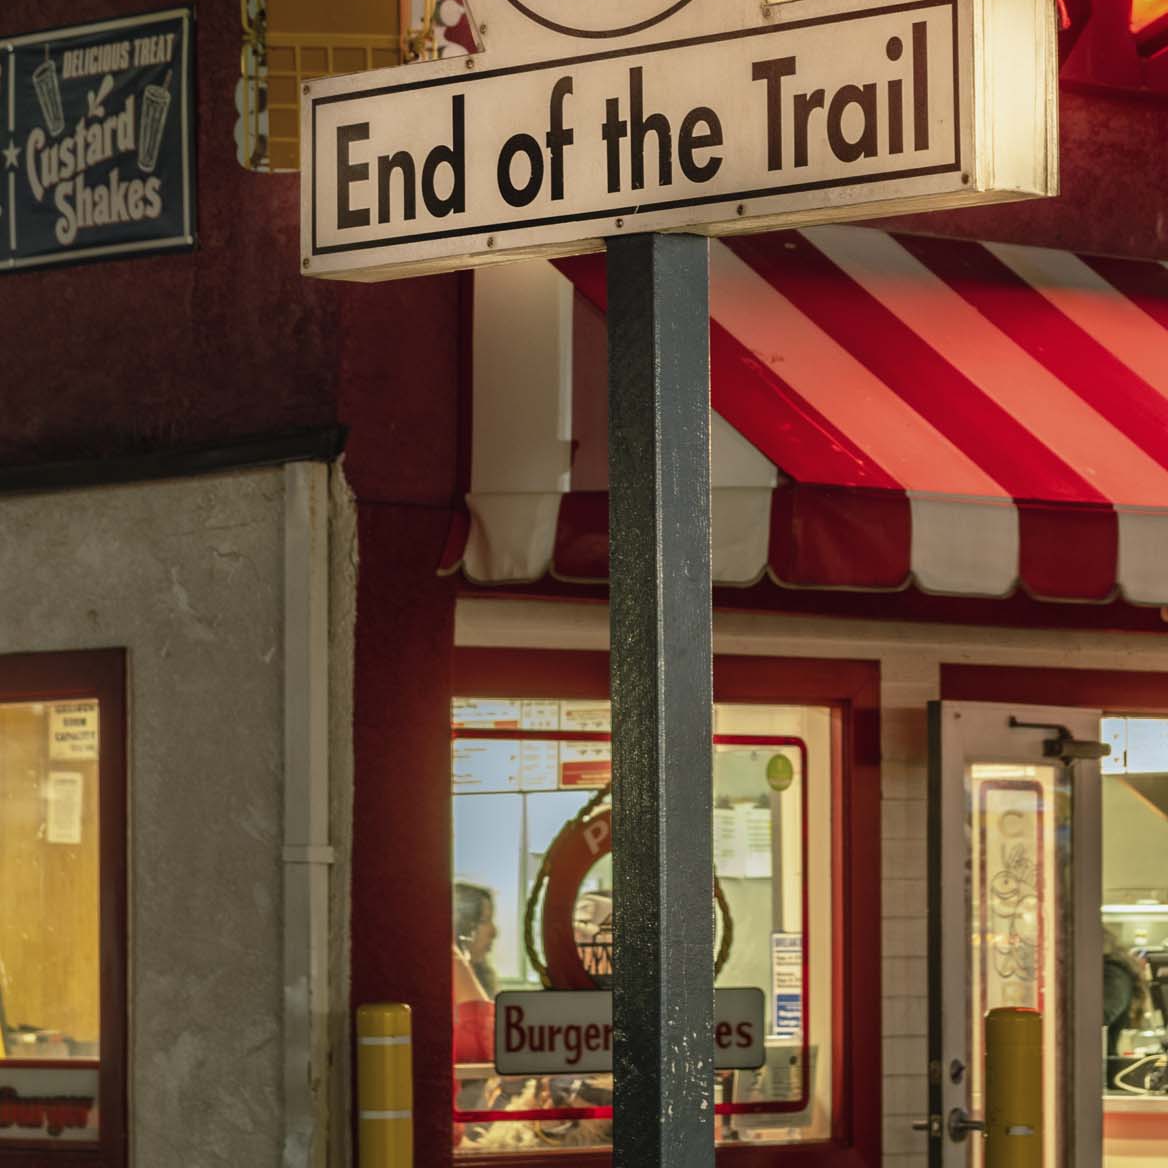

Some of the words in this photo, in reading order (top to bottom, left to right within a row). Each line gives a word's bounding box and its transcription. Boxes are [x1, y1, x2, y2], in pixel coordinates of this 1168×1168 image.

[63, 40, 130, 79] DELICIOUS
[134, 34, 176, 67] TREAT
[26, 94, 136, 202] Custard
[337, 94, 465, 229] End
[497, 76, 573, 207] of
[601, 66, 723, 193] the
[751, 21, 928, 172] Trail
[55, 168, 162, 245] Shakes
